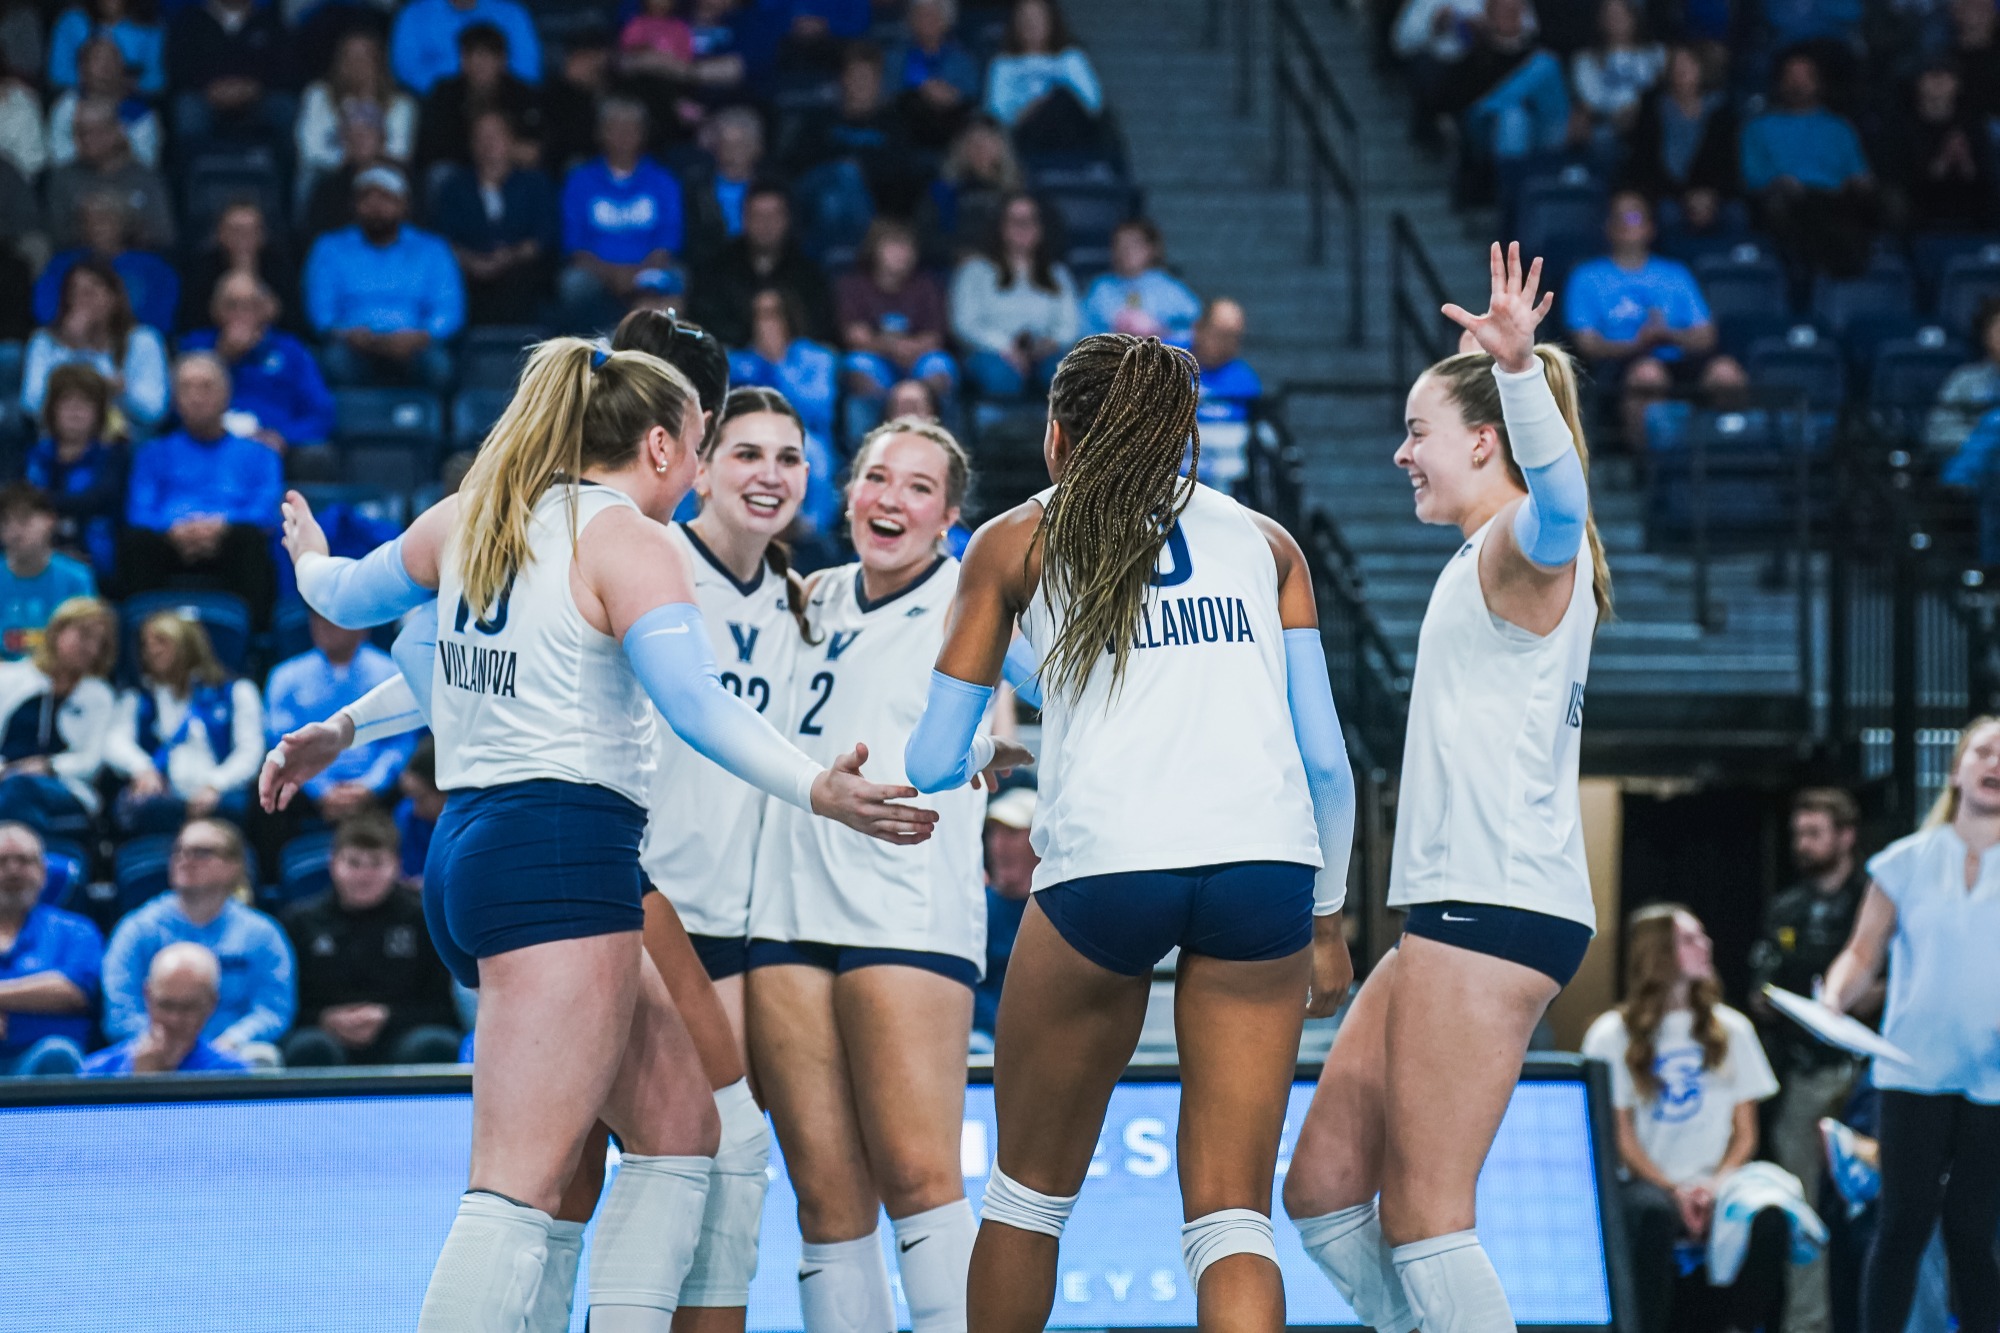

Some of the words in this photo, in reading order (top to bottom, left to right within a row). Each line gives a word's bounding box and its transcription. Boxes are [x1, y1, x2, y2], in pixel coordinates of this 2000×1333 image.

[1103, 597, 1255, 654] LLANOVA
[438, 640, 517, 697] VILLANOVA
[799, 671, 834, 735] 2
